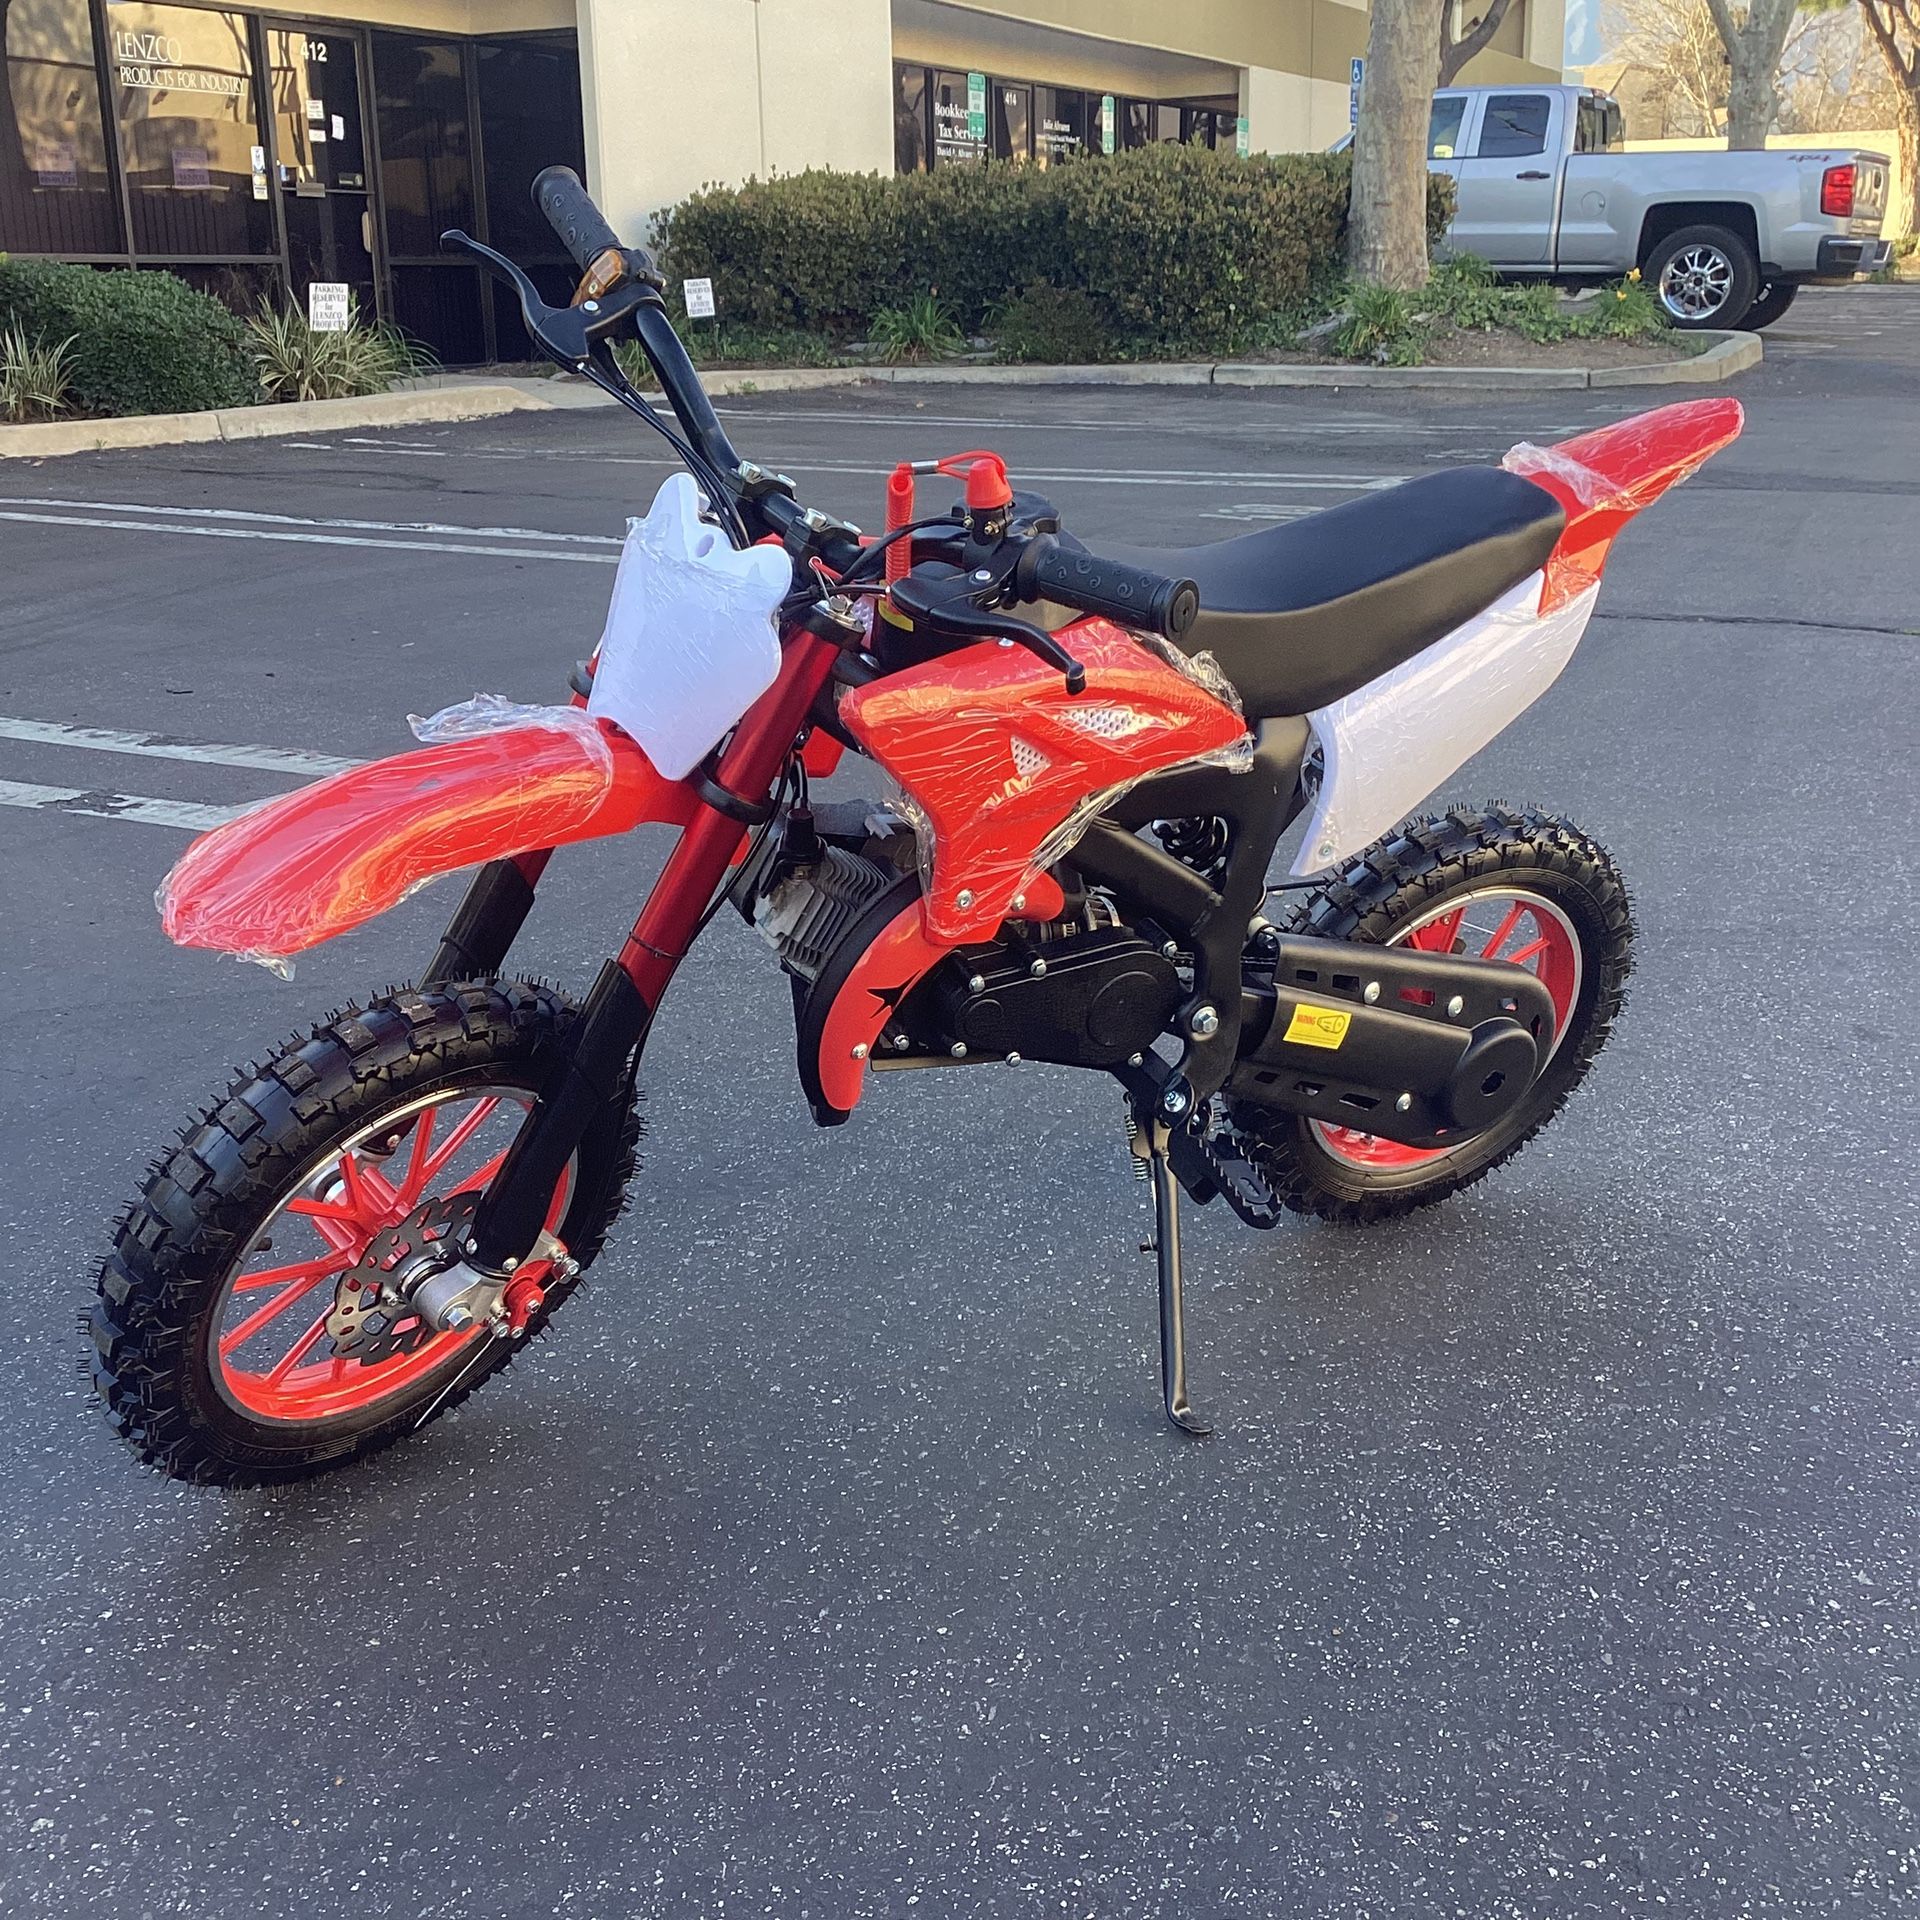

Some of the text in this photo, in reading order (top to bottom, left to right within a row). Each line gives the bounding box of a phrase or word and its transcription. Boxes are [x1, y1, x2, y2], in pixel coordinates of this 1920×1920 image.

[116, 31, 182, 63] LENZCO
[301, 41, 328, 62] 412
[120, 66, 246, 93] PRODUCTS FOR INDUSTRY
[1004, 92, 1017, 106] 414
[934, 101, 970, 119] Bookkee
[938, 123, 953, 138] Tax
[315, 285, 344, 293] PARKING
[312, 293, 347, 302] RESERVED
[315, 311, 343, 320] LENZCO
